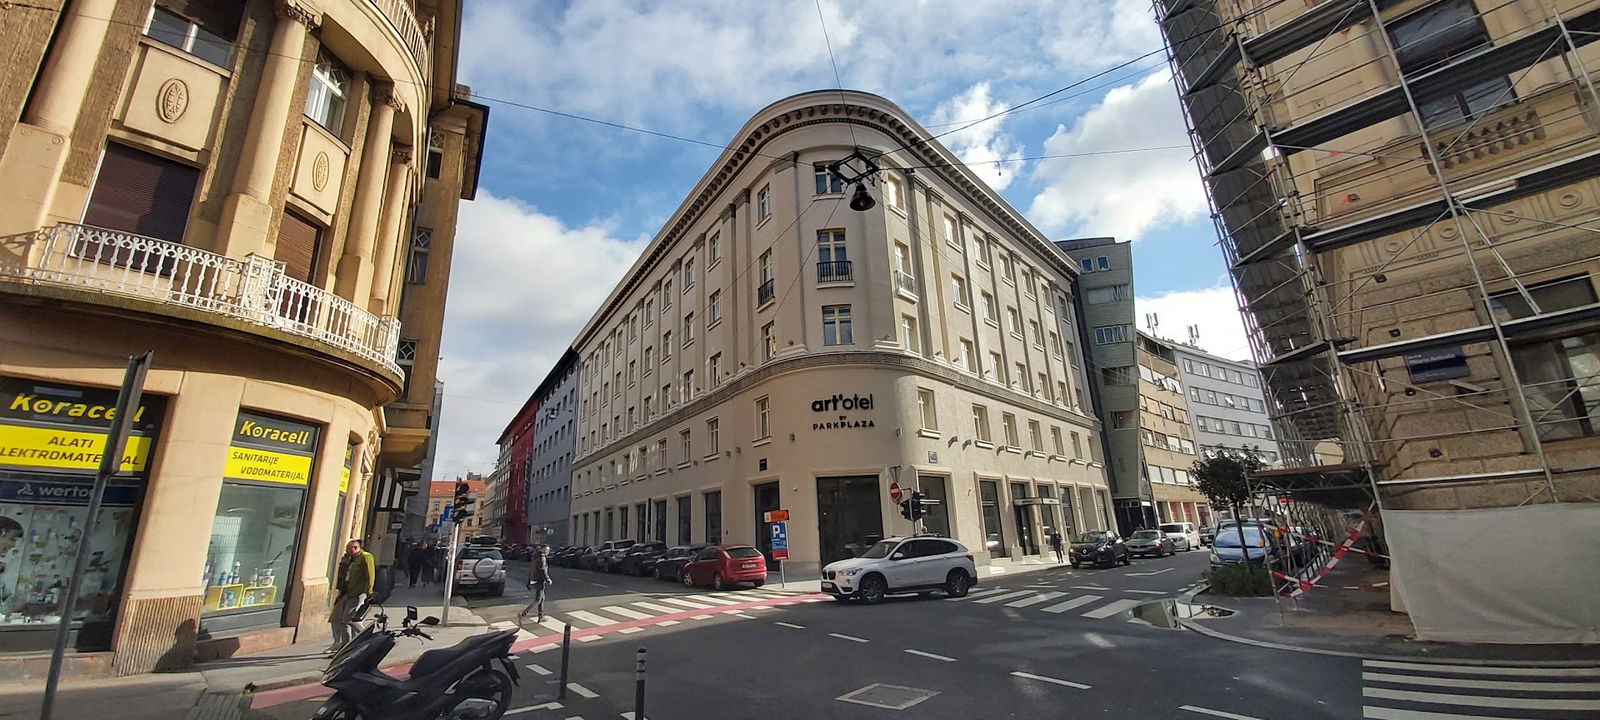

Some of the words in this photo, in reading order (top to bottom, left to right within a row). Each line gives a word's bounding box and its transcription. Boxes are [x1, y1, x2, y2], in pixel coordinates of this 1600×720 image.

[10, 393, 145, 422] Koracel
[811, 393, 874, 412] art'otel
[240, 420, 309, 445] Koracell
[48, 436, 94, 448] ALATI
[0, 447, 139, 465] LEKTROMATEAL
[232, 451, 279, 466] SANITARIJE
[240, 466, 305, 480] VODOMATERIJAL
[39, 486, 91, 497] werto
[772, 525, 781, 537] P
